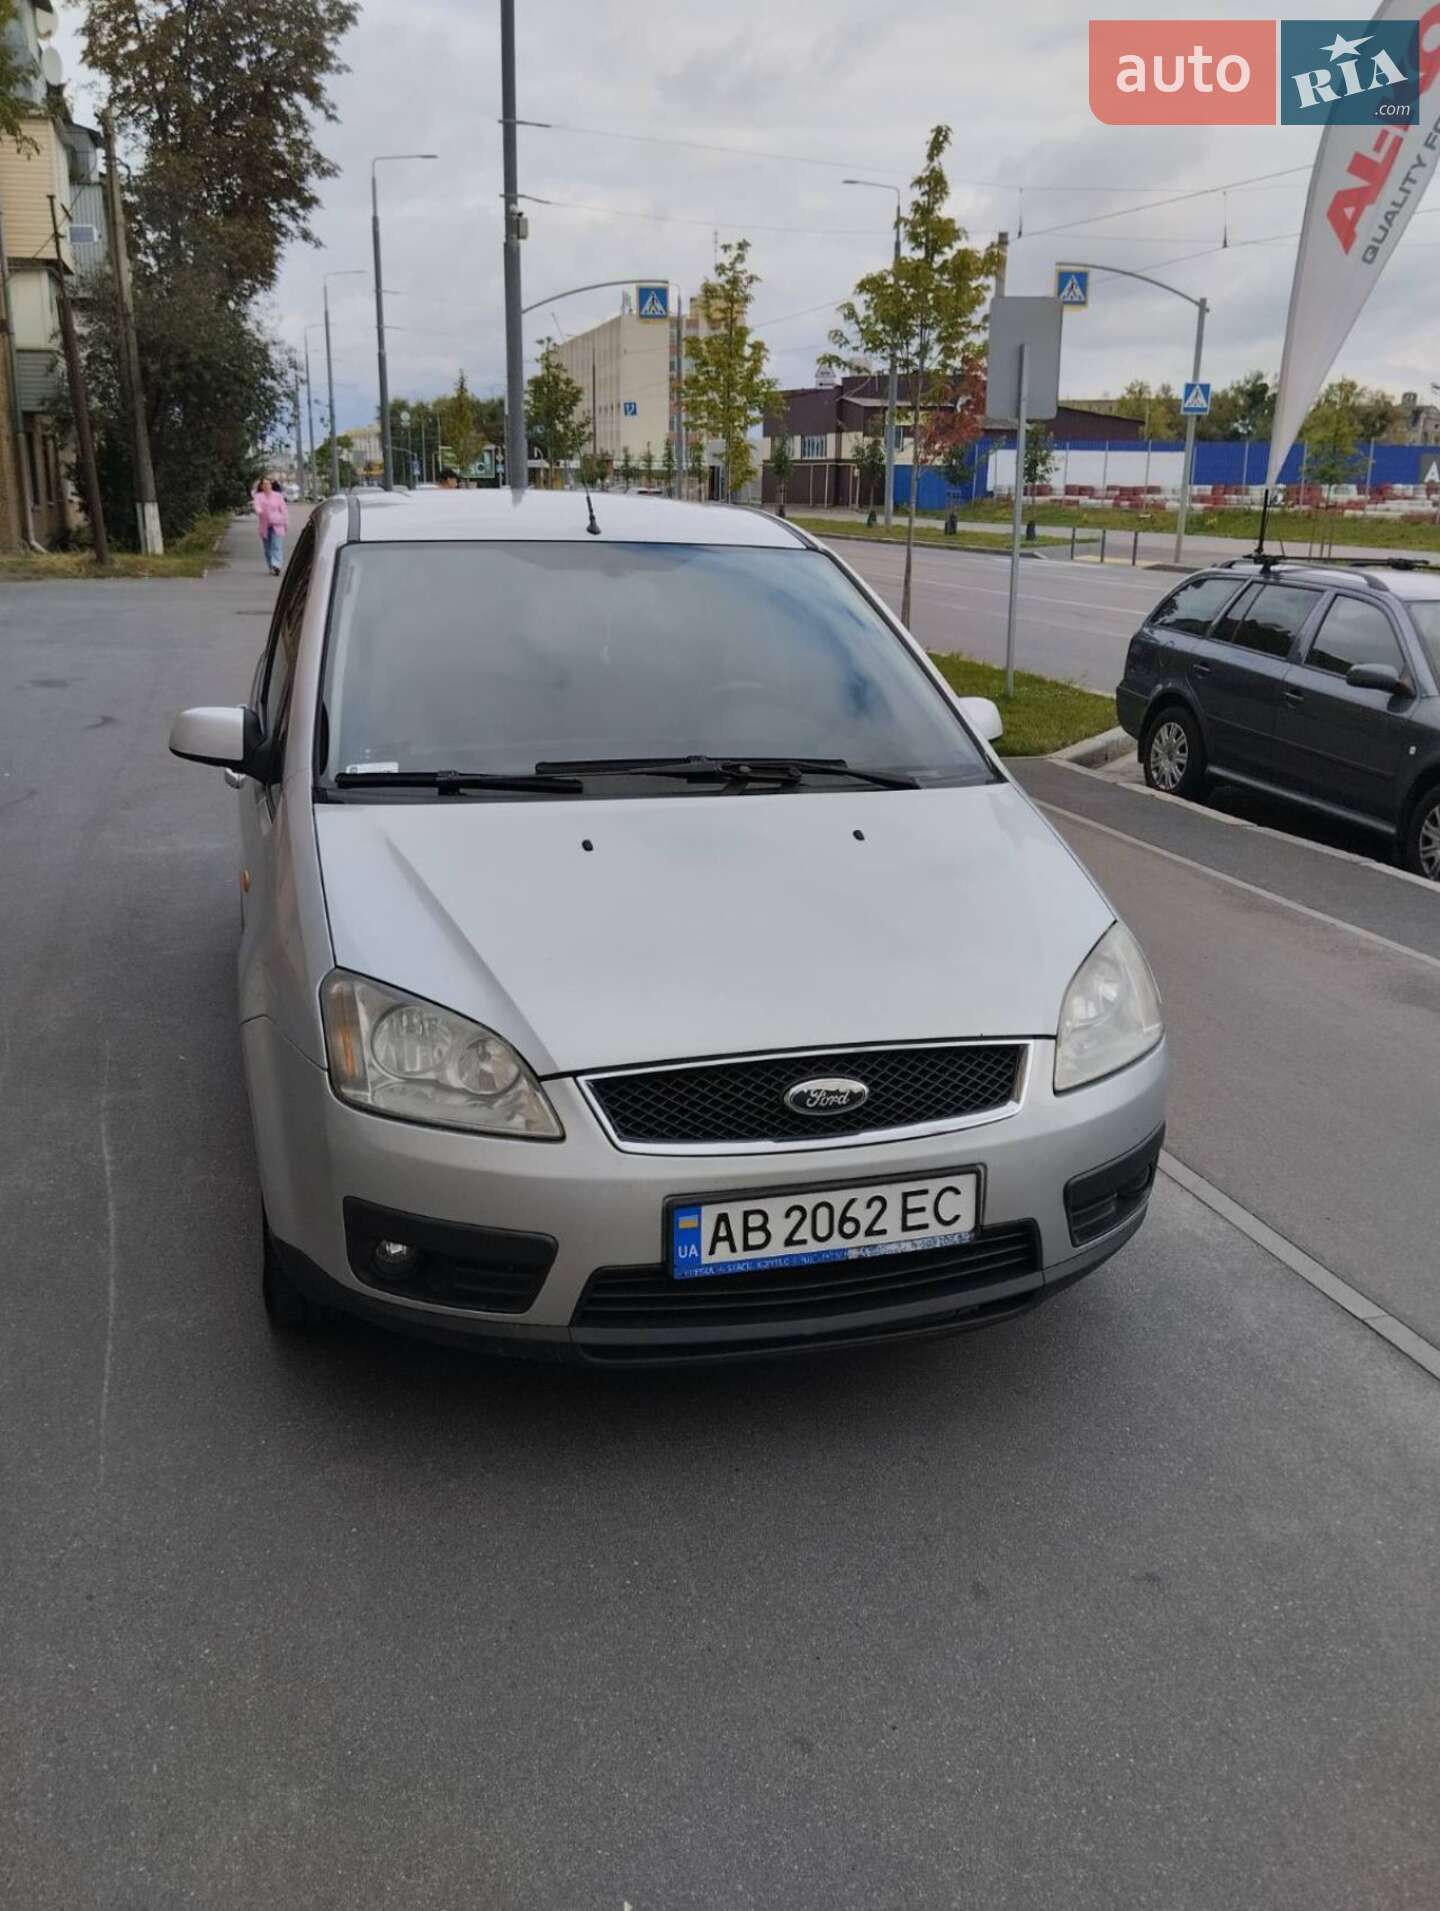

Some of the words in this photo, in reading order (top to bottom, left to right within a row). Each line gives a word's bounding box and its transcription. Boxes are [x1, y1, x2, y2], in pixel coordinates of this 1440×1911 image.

[1361, 153, 1427, 264] QUALITY
[806, 1088, 849, 1107] Ford
[708, 1209, 772, 1256] AB
[783, 1195, 888, 1247] 2062
[901, 1186, 962, 1232] EC
[678, 1244, 699, 1258] UA
